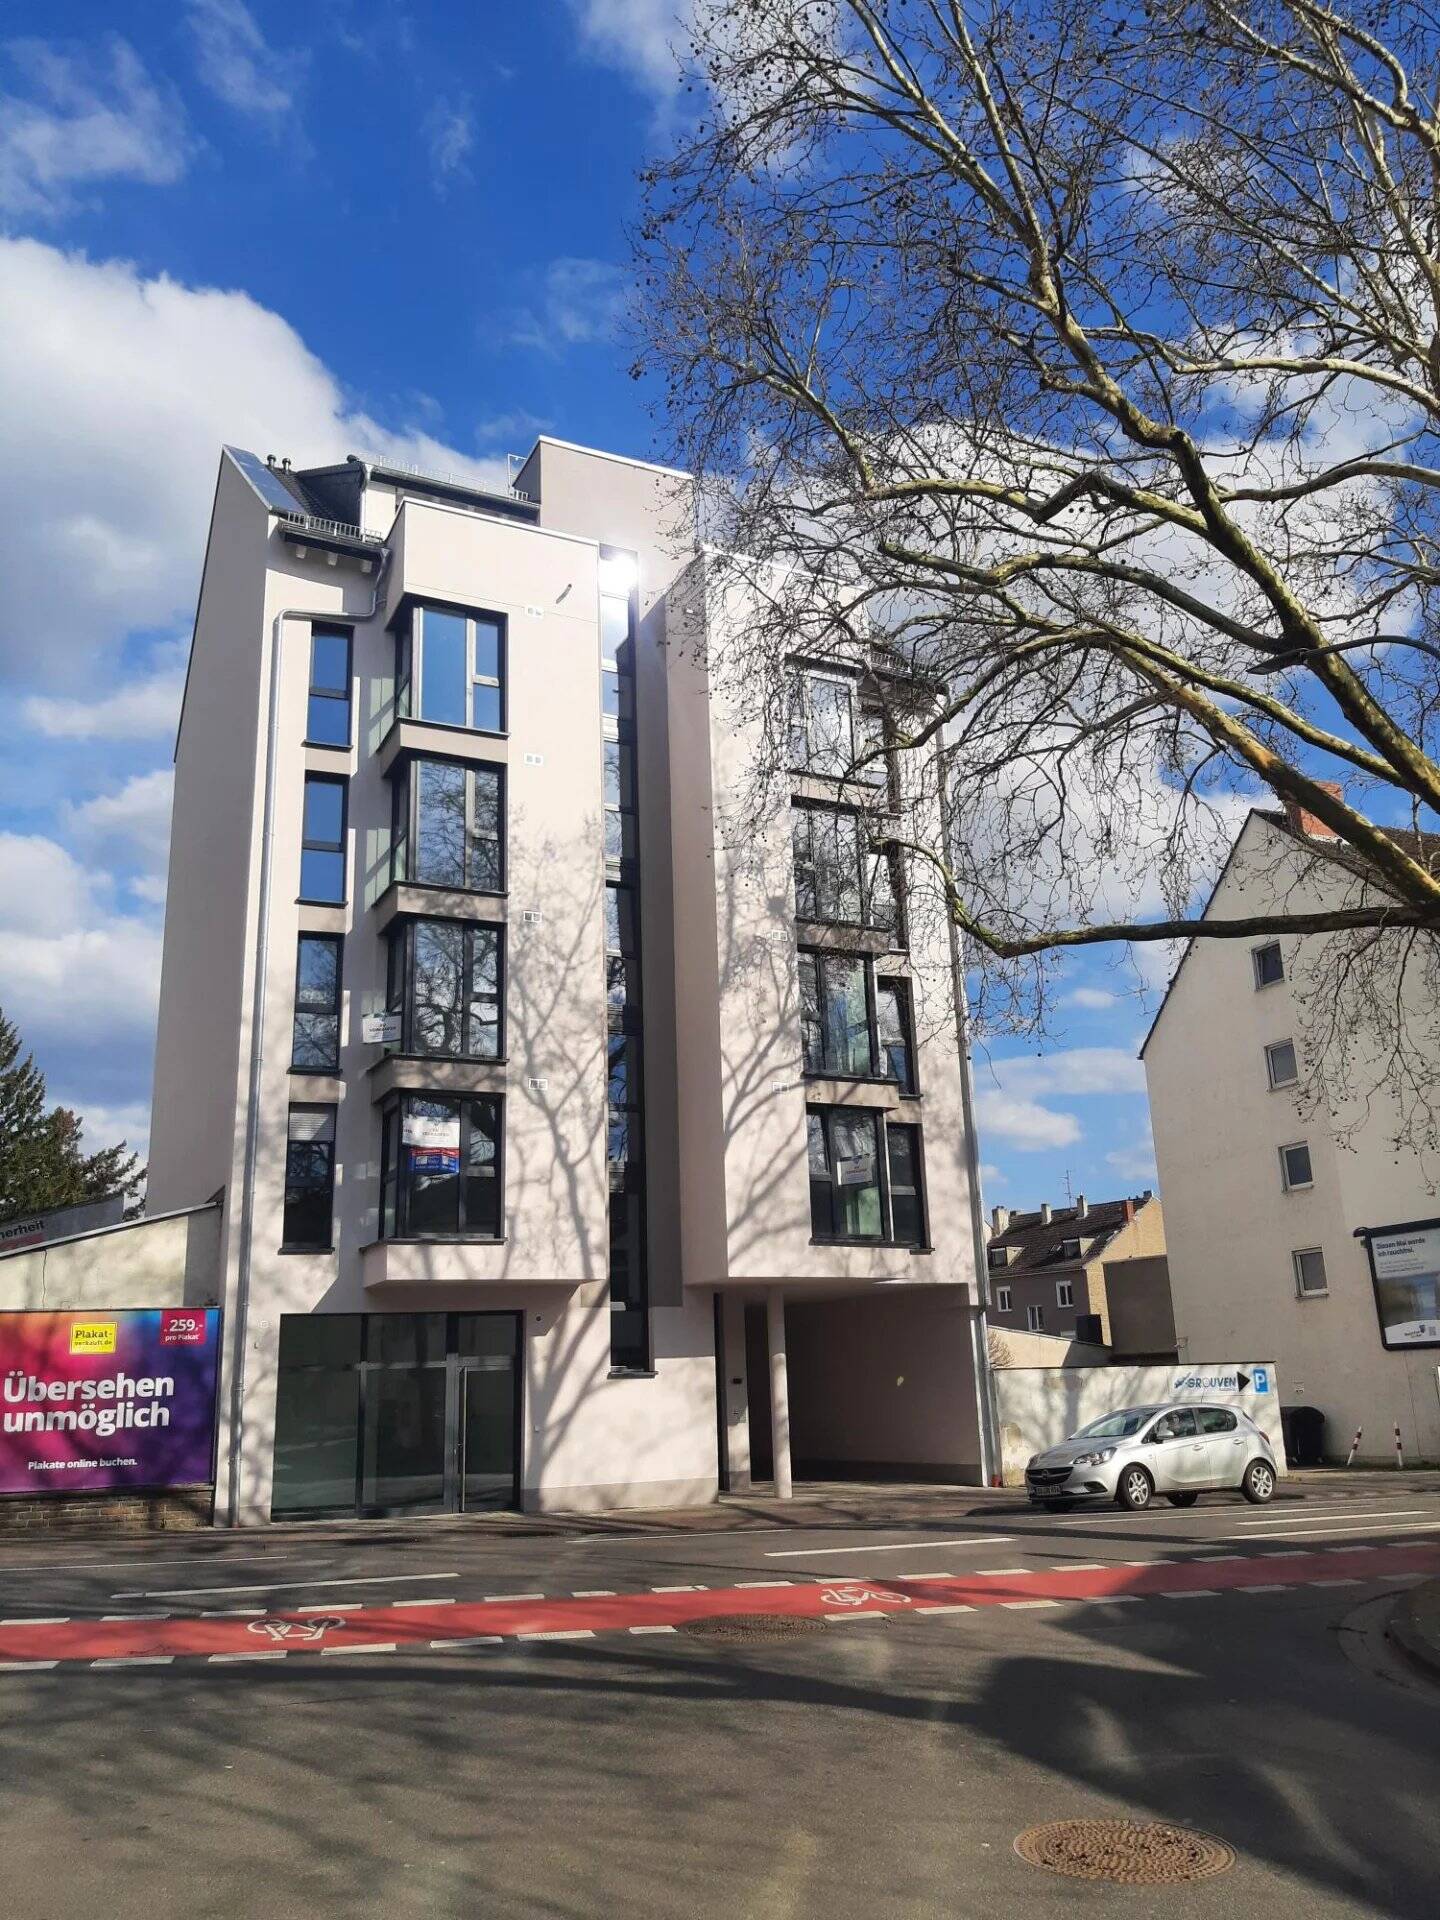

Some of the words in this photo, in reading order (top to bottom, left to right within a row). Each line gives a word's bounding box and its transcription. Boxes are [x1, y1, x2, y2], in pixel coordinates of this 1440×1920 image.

[4, 1370, 175, 1403] Übersehen
[1255, 1372, 1266, 1390] P
[3, 1401, 170, 1437] unmöglich
[28, 1460, 65, 1471] Plakate
[67, 1459, 98, 1469] online
[99, 1457, 138, 1468] buchen.
